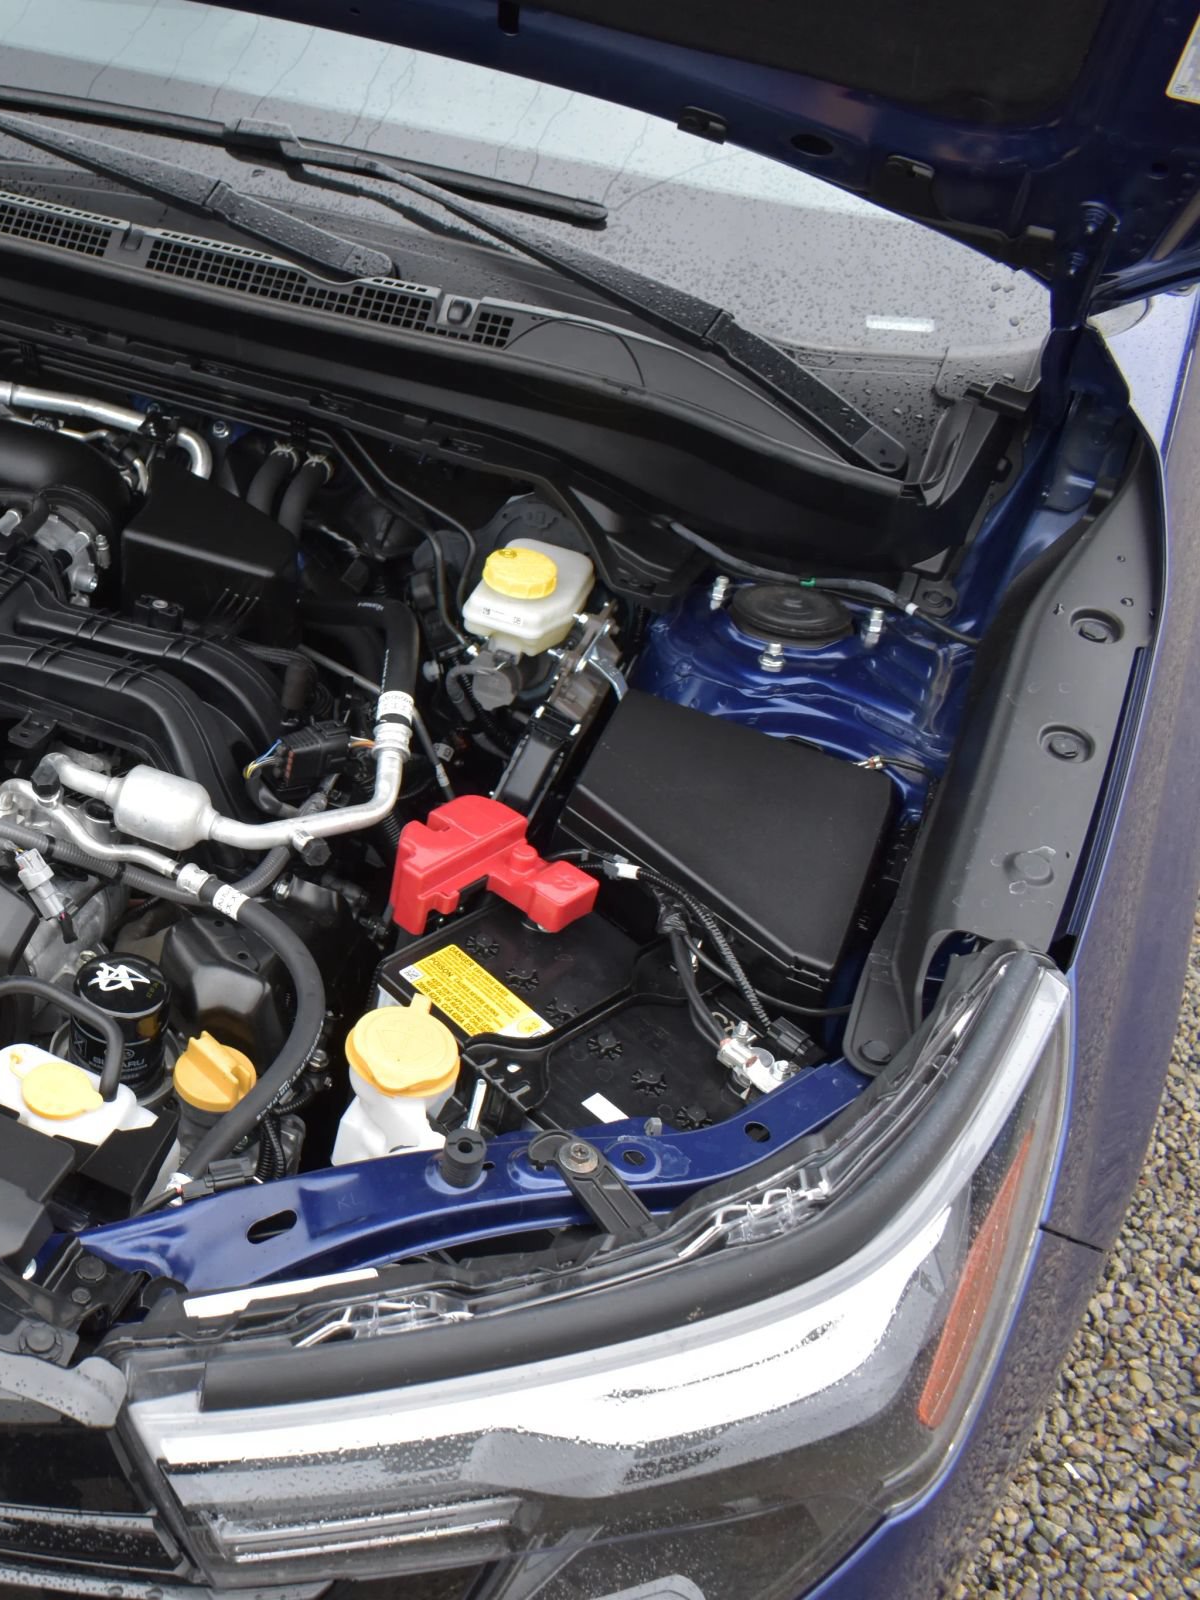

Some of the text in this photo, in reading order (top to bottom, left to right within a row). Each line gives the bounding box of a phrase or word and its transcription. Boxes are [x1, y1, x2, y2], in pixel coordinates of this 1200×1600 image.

[447, 946, 474, 967] DANGER
[427, 957, 453, 977] POISON
[452, 977, 471, 992] CAUSES
[467, 991, 485, 1004] SEVERE
